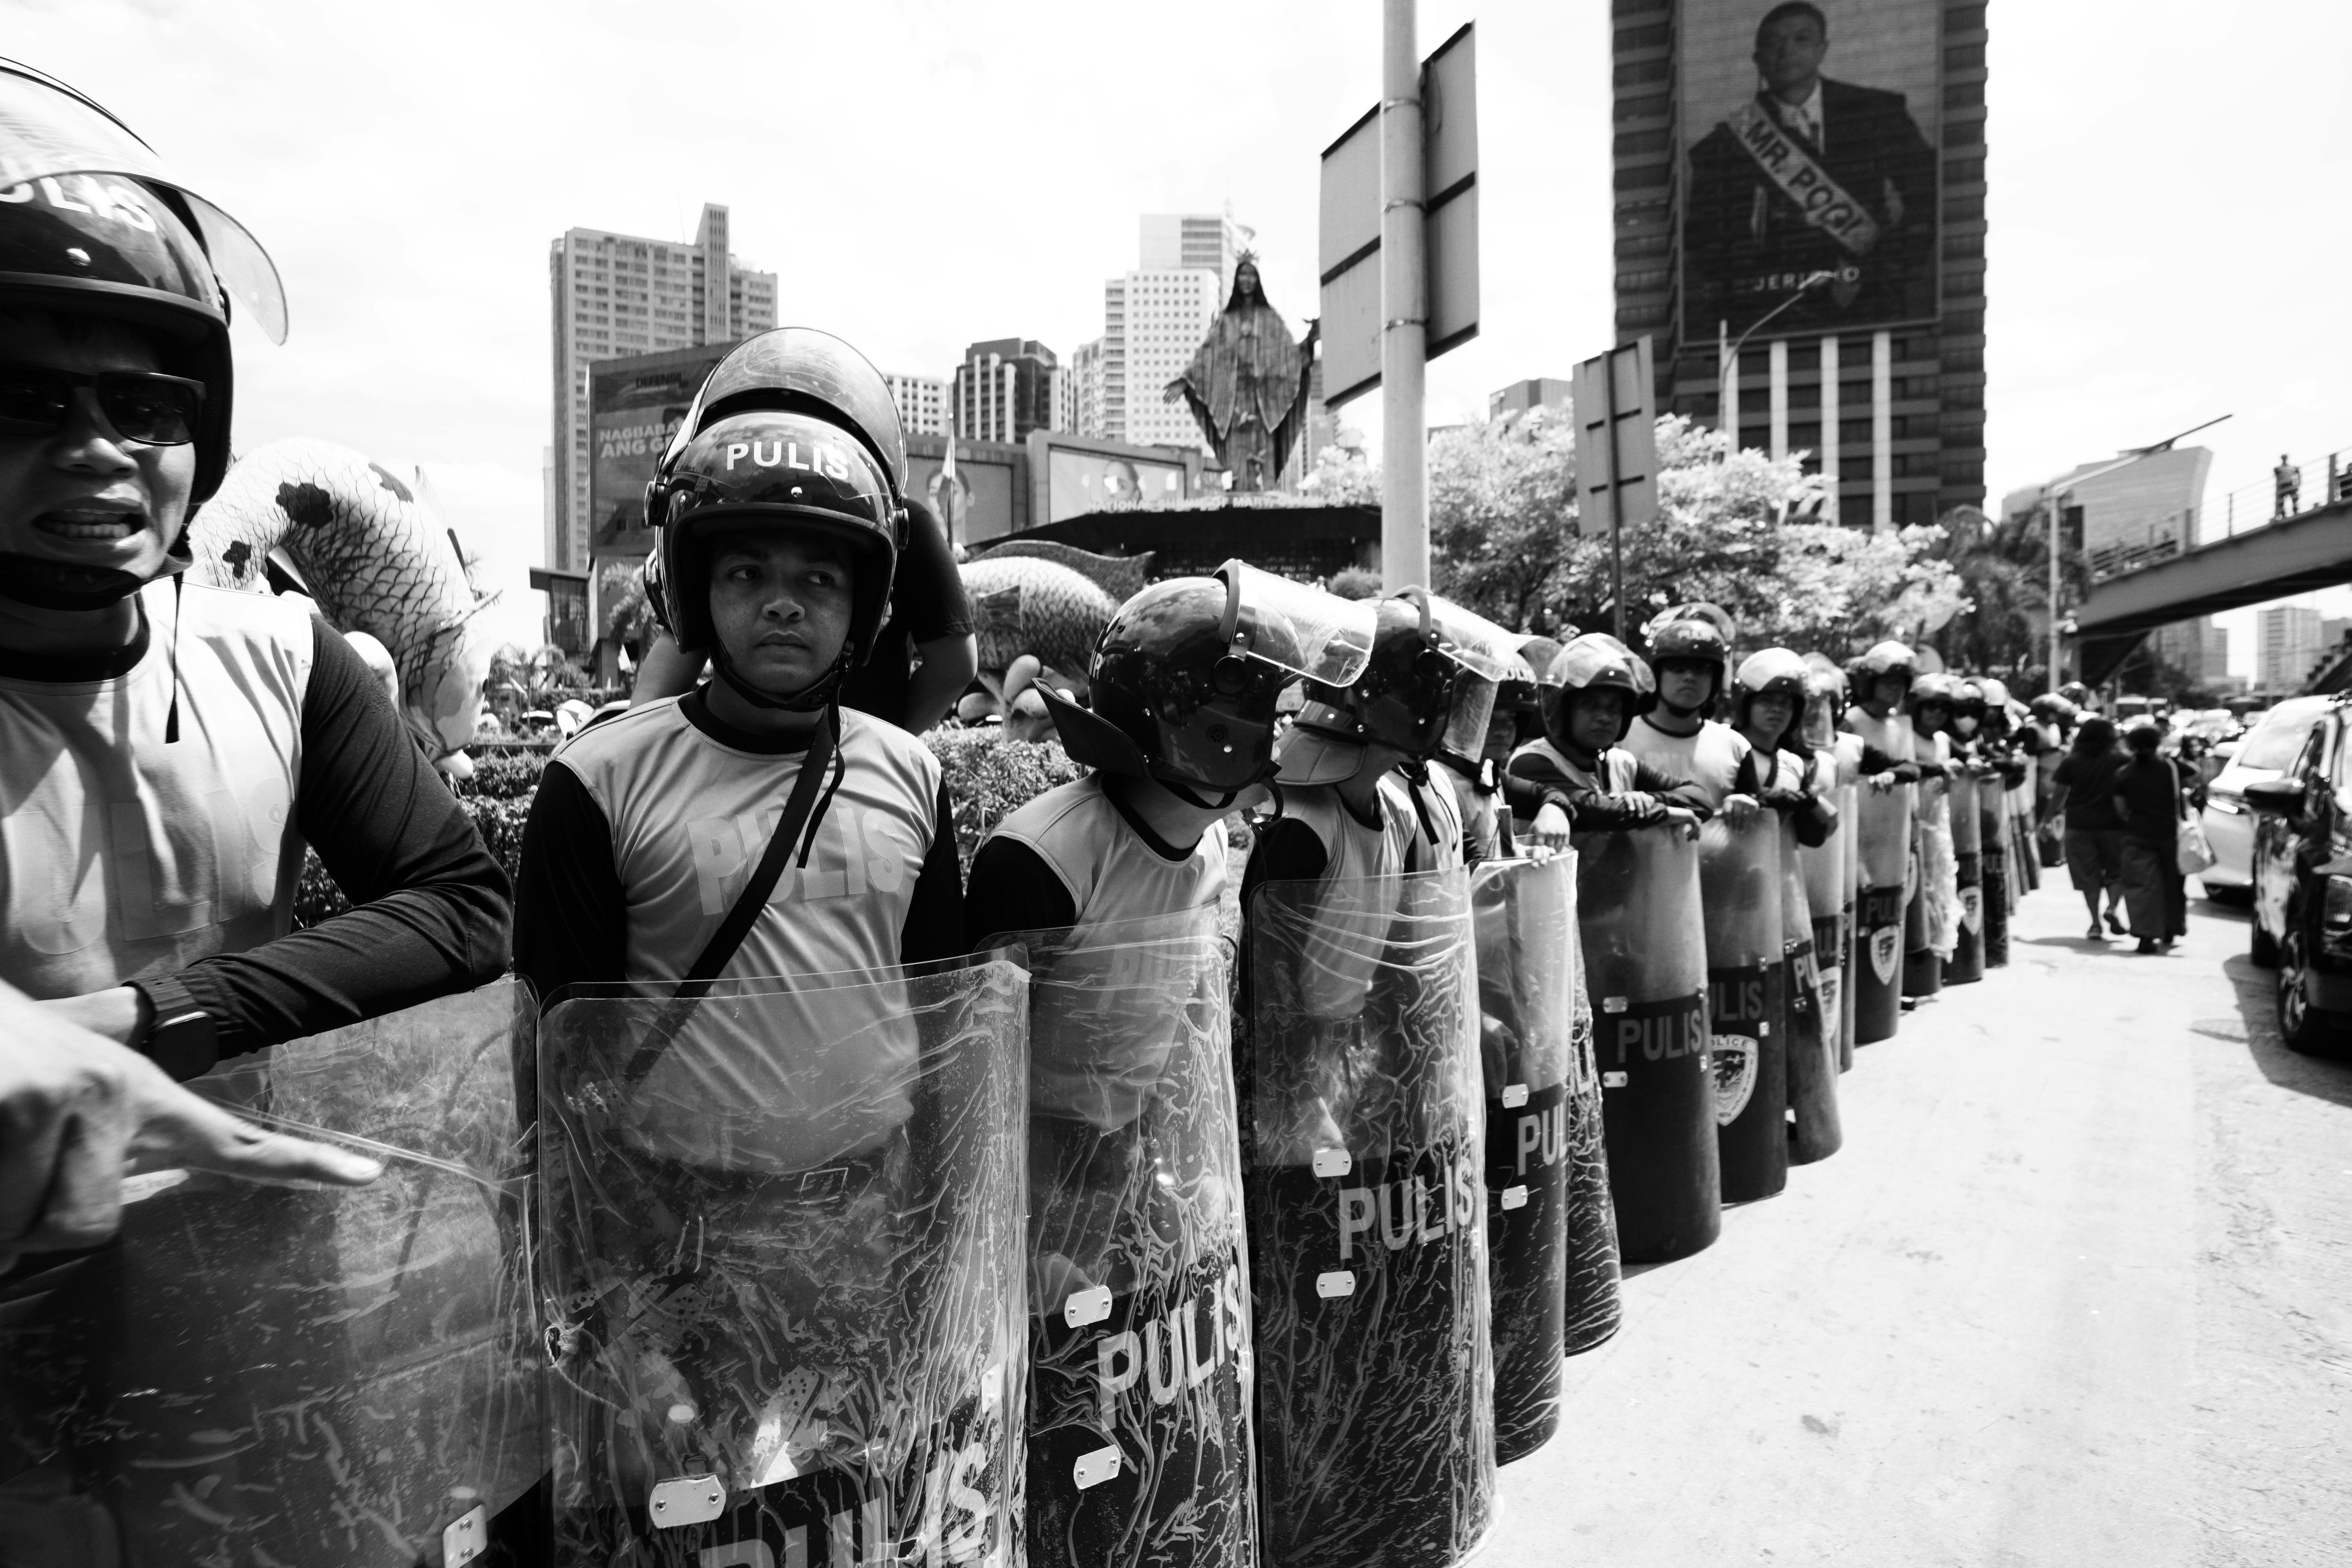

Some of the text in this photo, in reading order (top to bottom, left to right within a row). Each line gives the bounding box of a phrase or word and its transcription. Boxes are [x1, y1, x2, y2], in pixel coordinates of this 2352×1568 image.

[1788, 166, 1864, 235] POGI
[600, 422, 681, 442] NAGBABA
[601, 438, 646, 458] ANG
[727, 441, 849, 480] PULIS
[1618, 1009, 1702, 1063] PULIS
[1338, 1157, 1474, 1260] PULIS
[1097, 1264, 1241, 1432] PULIS
